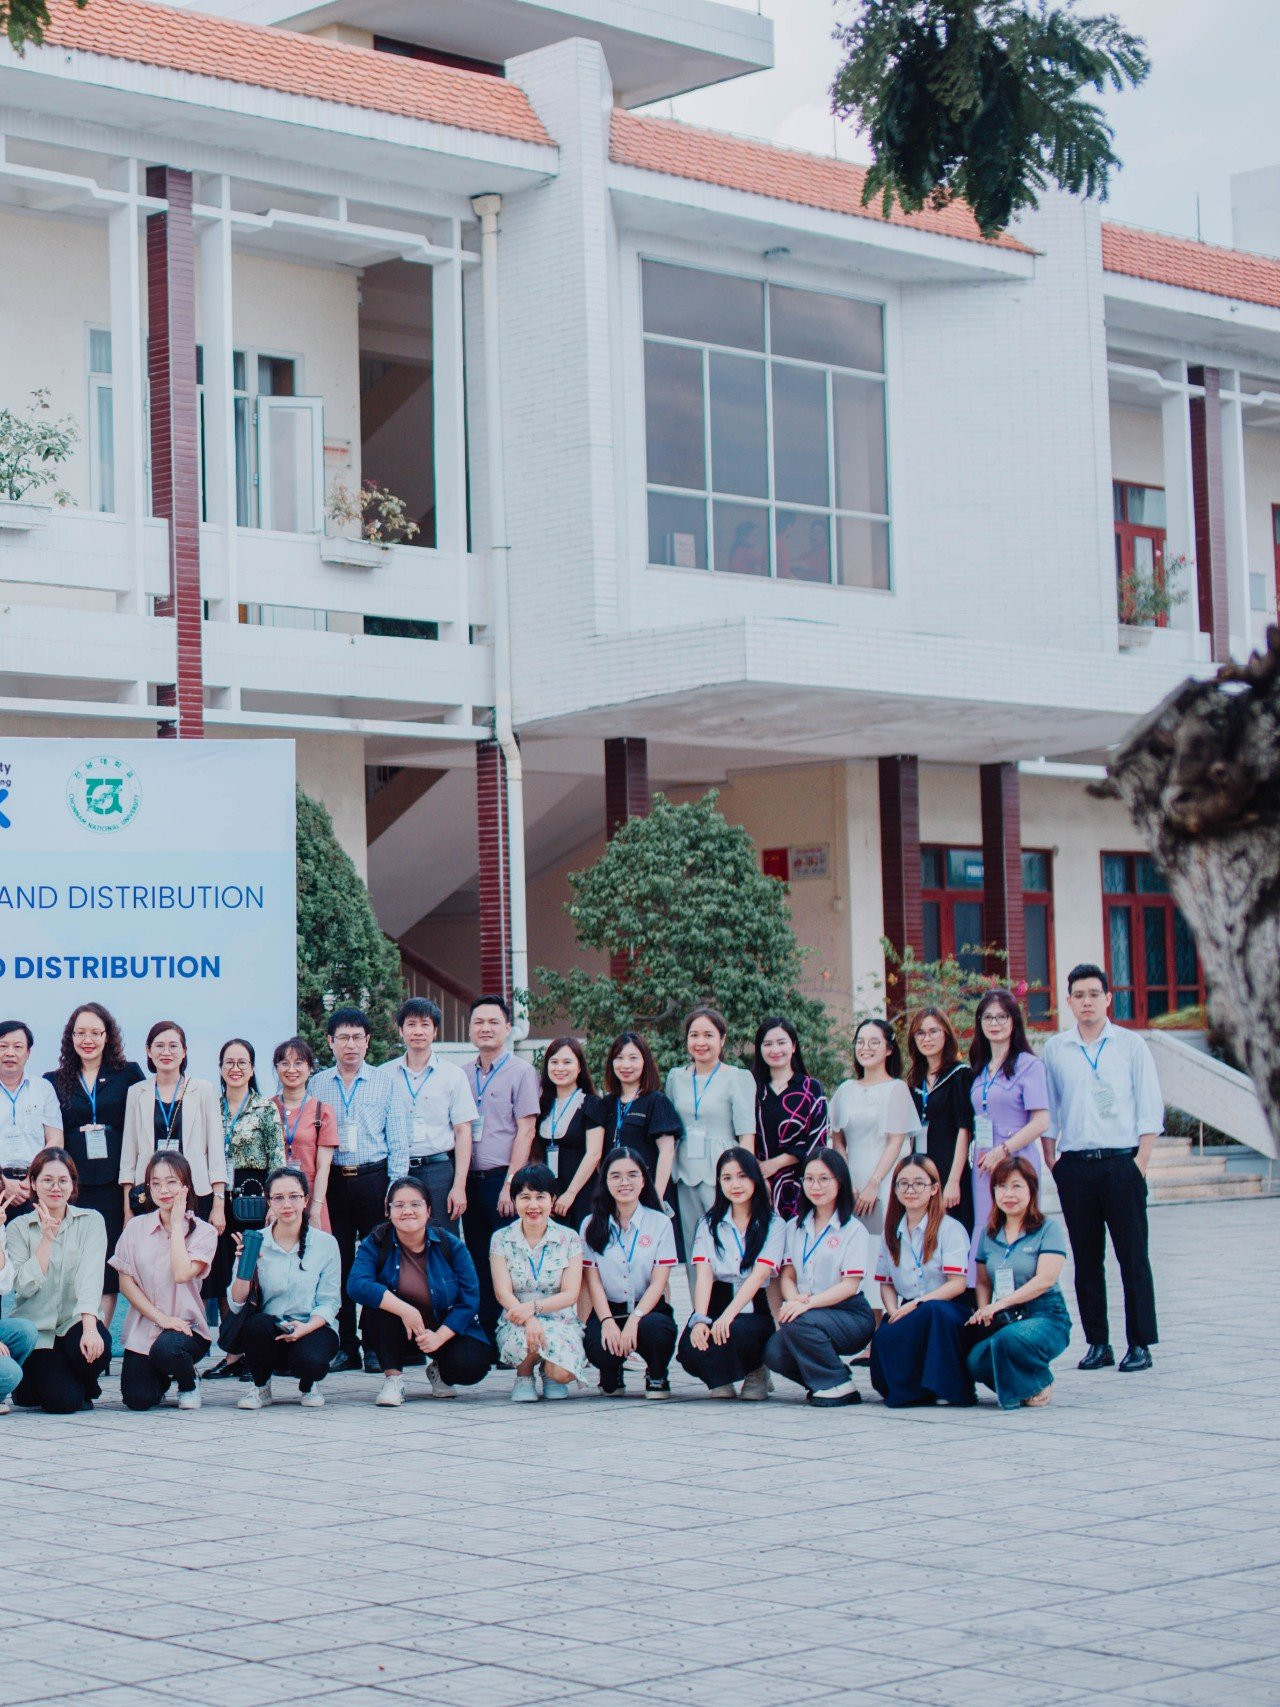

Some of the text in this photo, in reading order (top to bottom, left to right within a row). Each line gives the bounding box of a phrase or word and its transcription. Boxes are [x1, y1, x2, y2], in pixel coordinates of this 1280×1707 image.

[88, 822, 120, 832] NATIONAL
[69, 885, 264, 910] DISTRIBUTION
[15, 955, 220, 980] DISTRIBUTION
